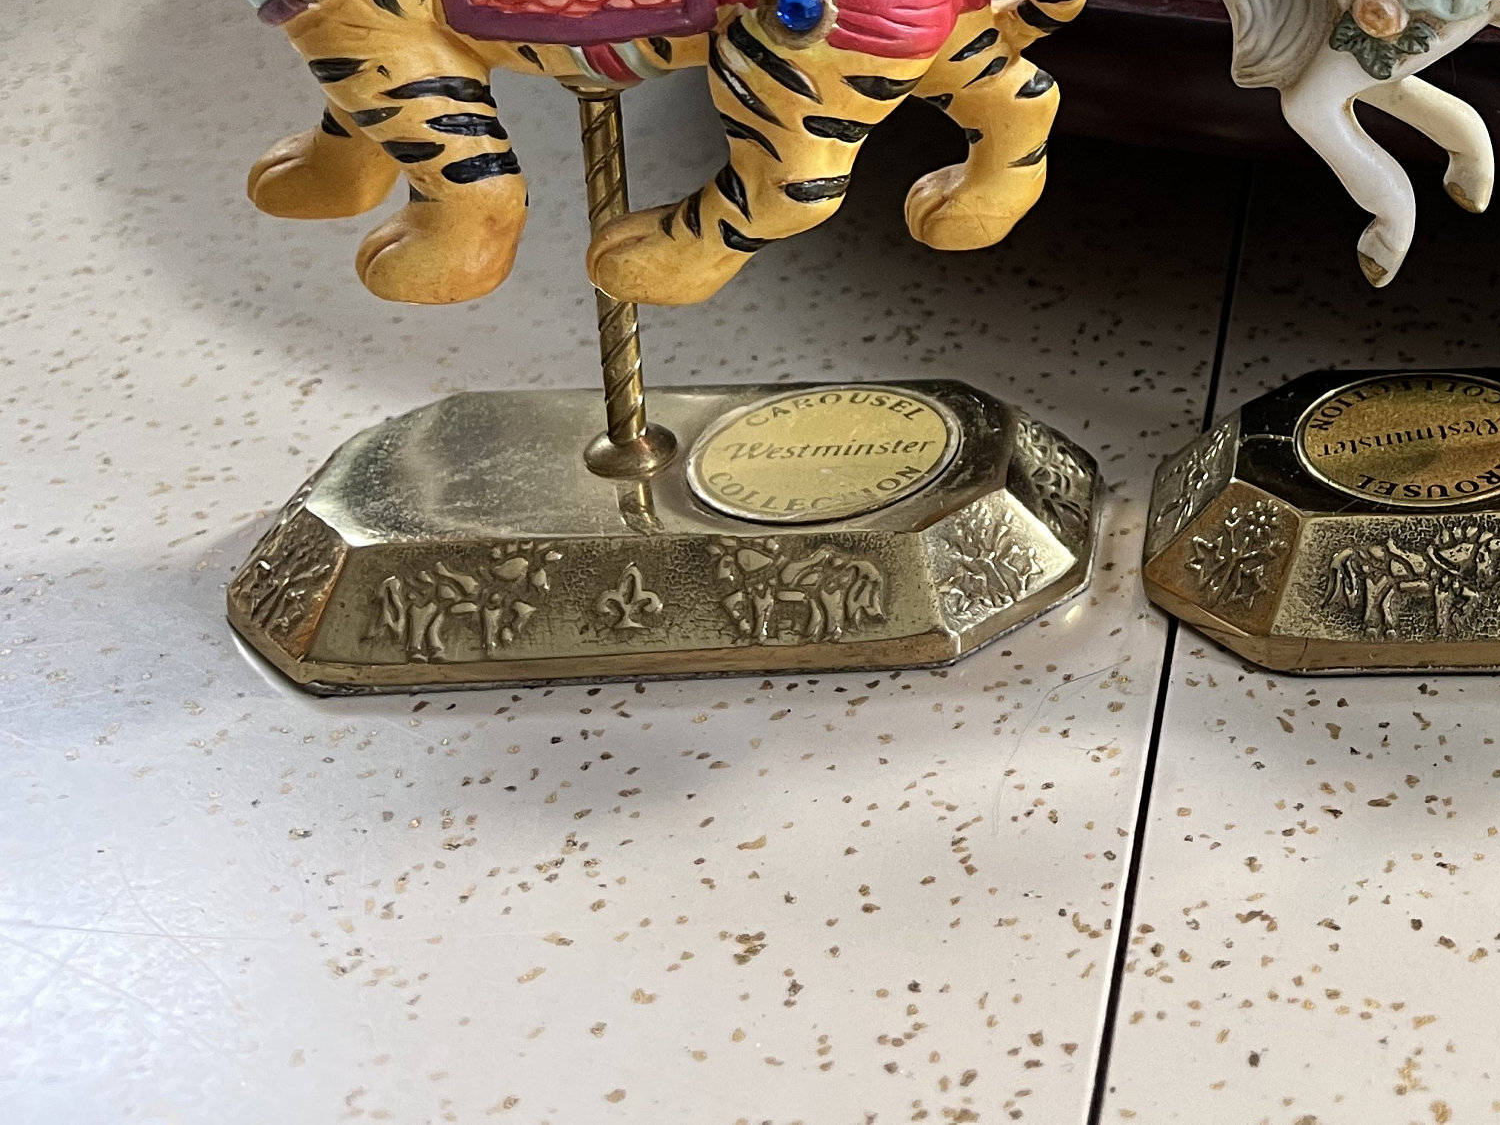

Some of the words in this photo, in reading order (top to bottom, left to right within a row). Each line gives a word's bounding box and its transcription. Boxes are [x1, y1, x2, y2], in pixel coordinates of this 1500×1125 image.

[746, 392, 925, 427] CAROUSEL
[724, 439, 936, 461] Westminster
[709, 465, 923, 512] COLLECION
